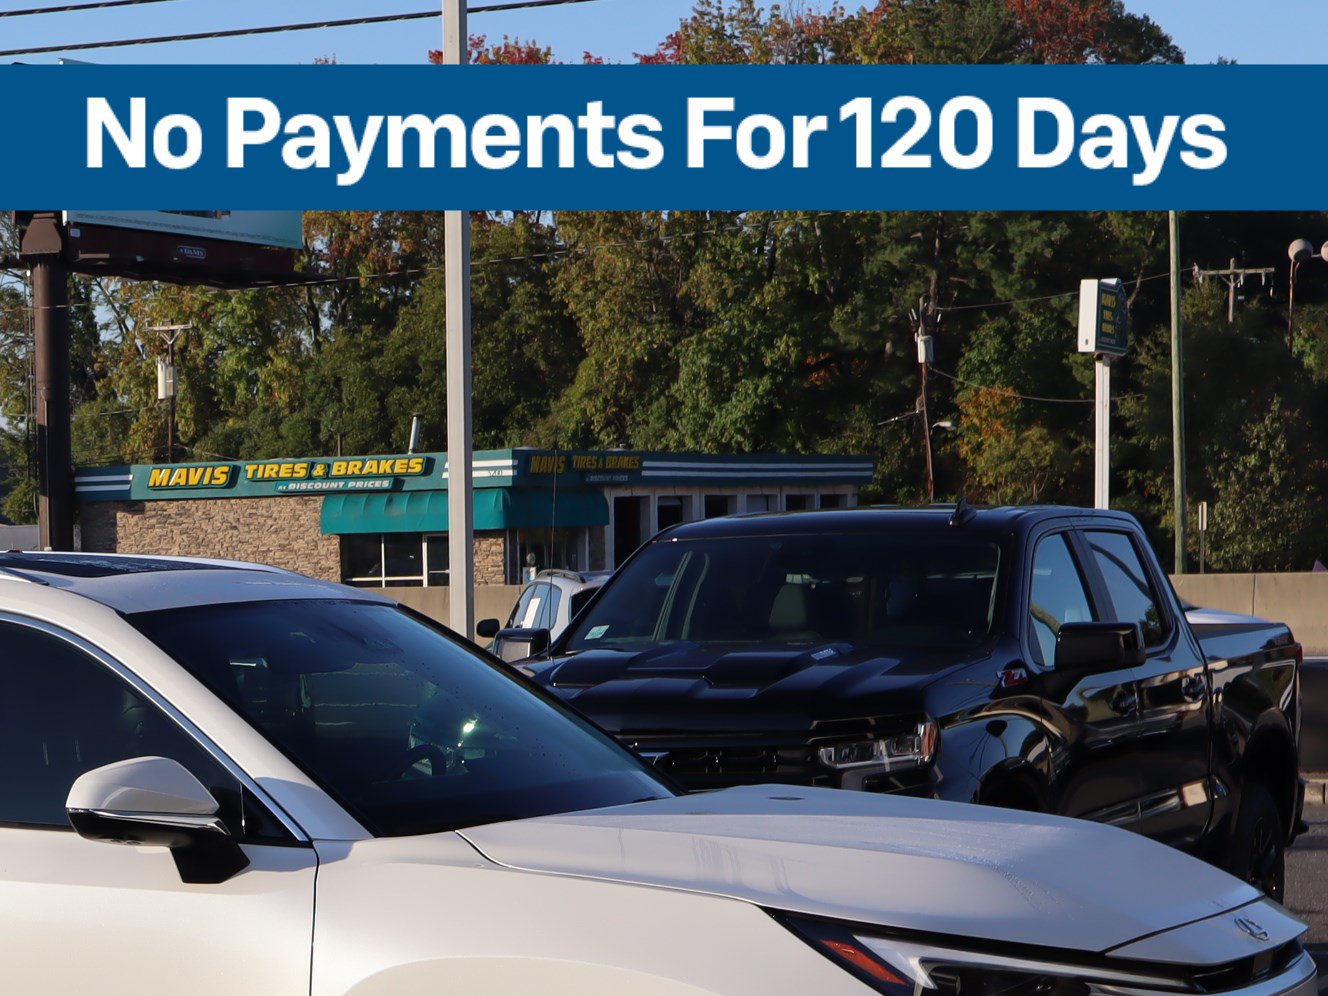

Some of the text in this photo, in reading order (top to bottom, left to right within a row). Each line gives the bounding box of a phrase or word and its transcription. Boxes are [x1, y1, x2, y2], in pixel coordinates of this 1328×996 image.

[148, 457, 424, 487] MAVIS TIRES & BRAKES
[287, 482, 345, 490] DISCOUNT
[347, 480, 390, 489] PRICES
